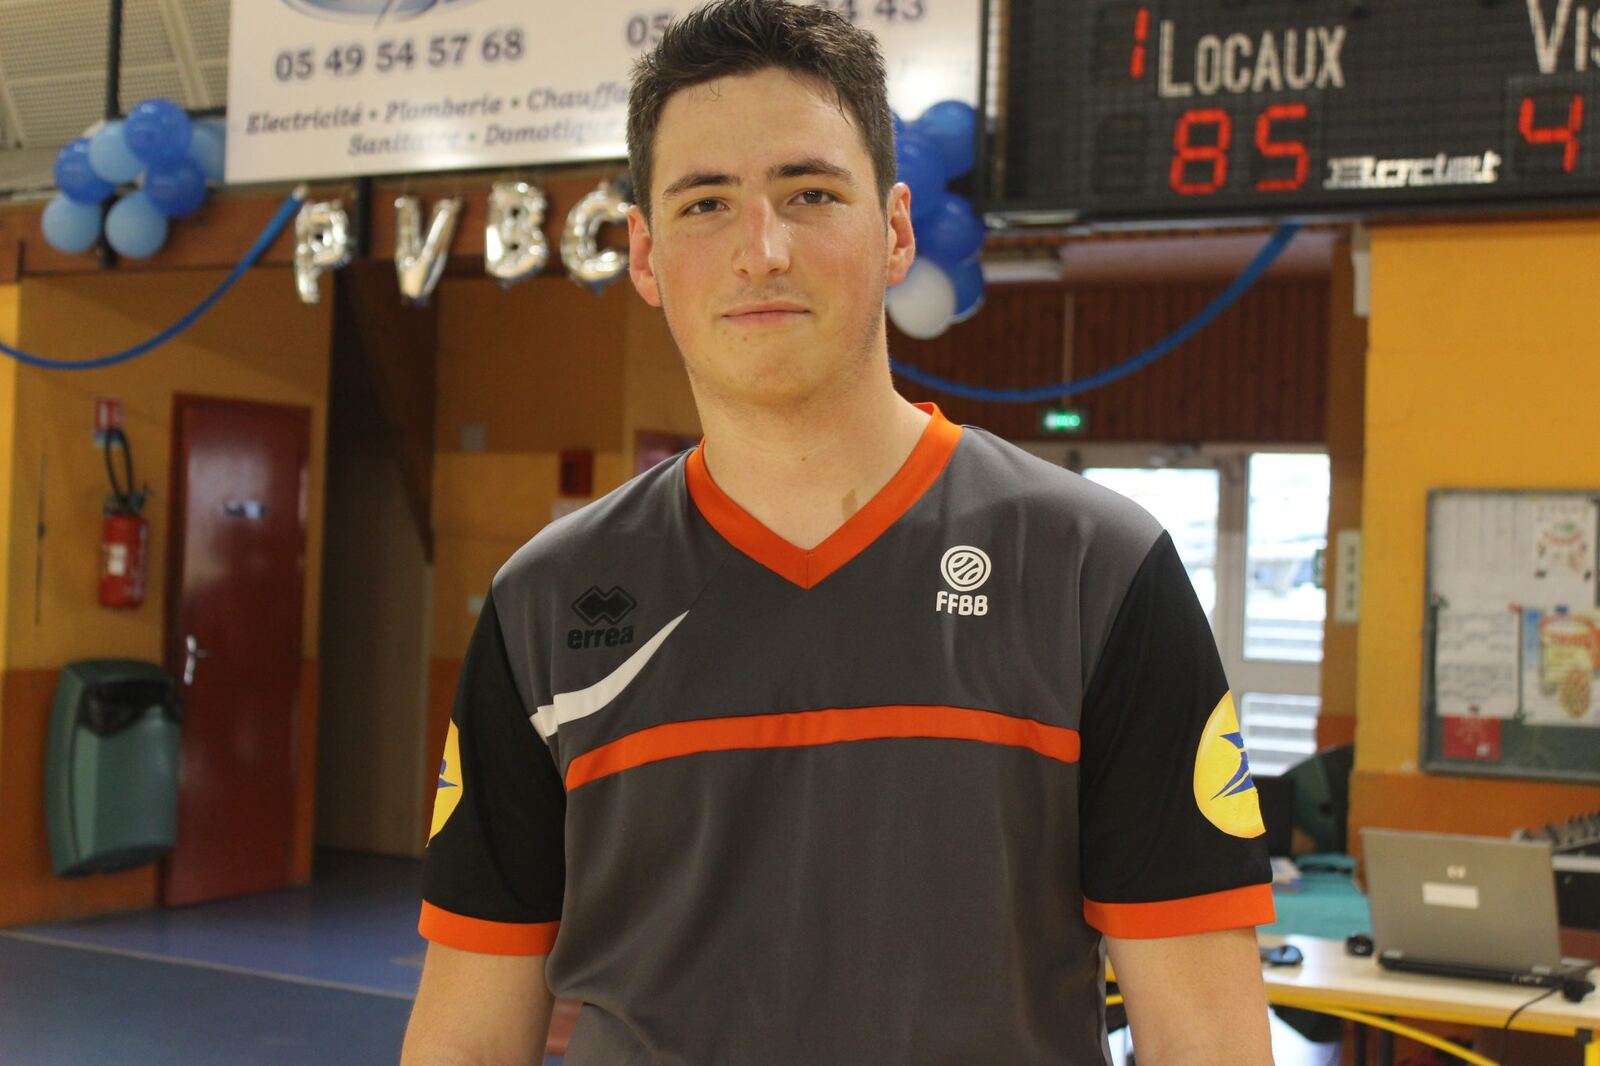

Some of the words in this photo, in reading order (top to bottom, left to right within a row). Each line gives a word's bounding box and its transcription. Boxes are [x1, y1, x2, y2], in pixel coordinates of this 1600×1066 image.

[274, 49, 314, 81] 05
[324, 42, 364, 75] 49
[375, 37, 415, 72] 54
[428, 33, 469, 67] 57
[481, 29, 525, 62] 68
[1158, 20, 1347, 98] LOCAUX
[246, 104, 362, 134] Electricité
[385, 91, 502, 122] Plomberie
[526, 82, 630, 111] Chauffa
[1519, 95, 1584, 174] 4
[1170, 103, 1309, 196] 85
[936, 591, 988, 616] FFBB
